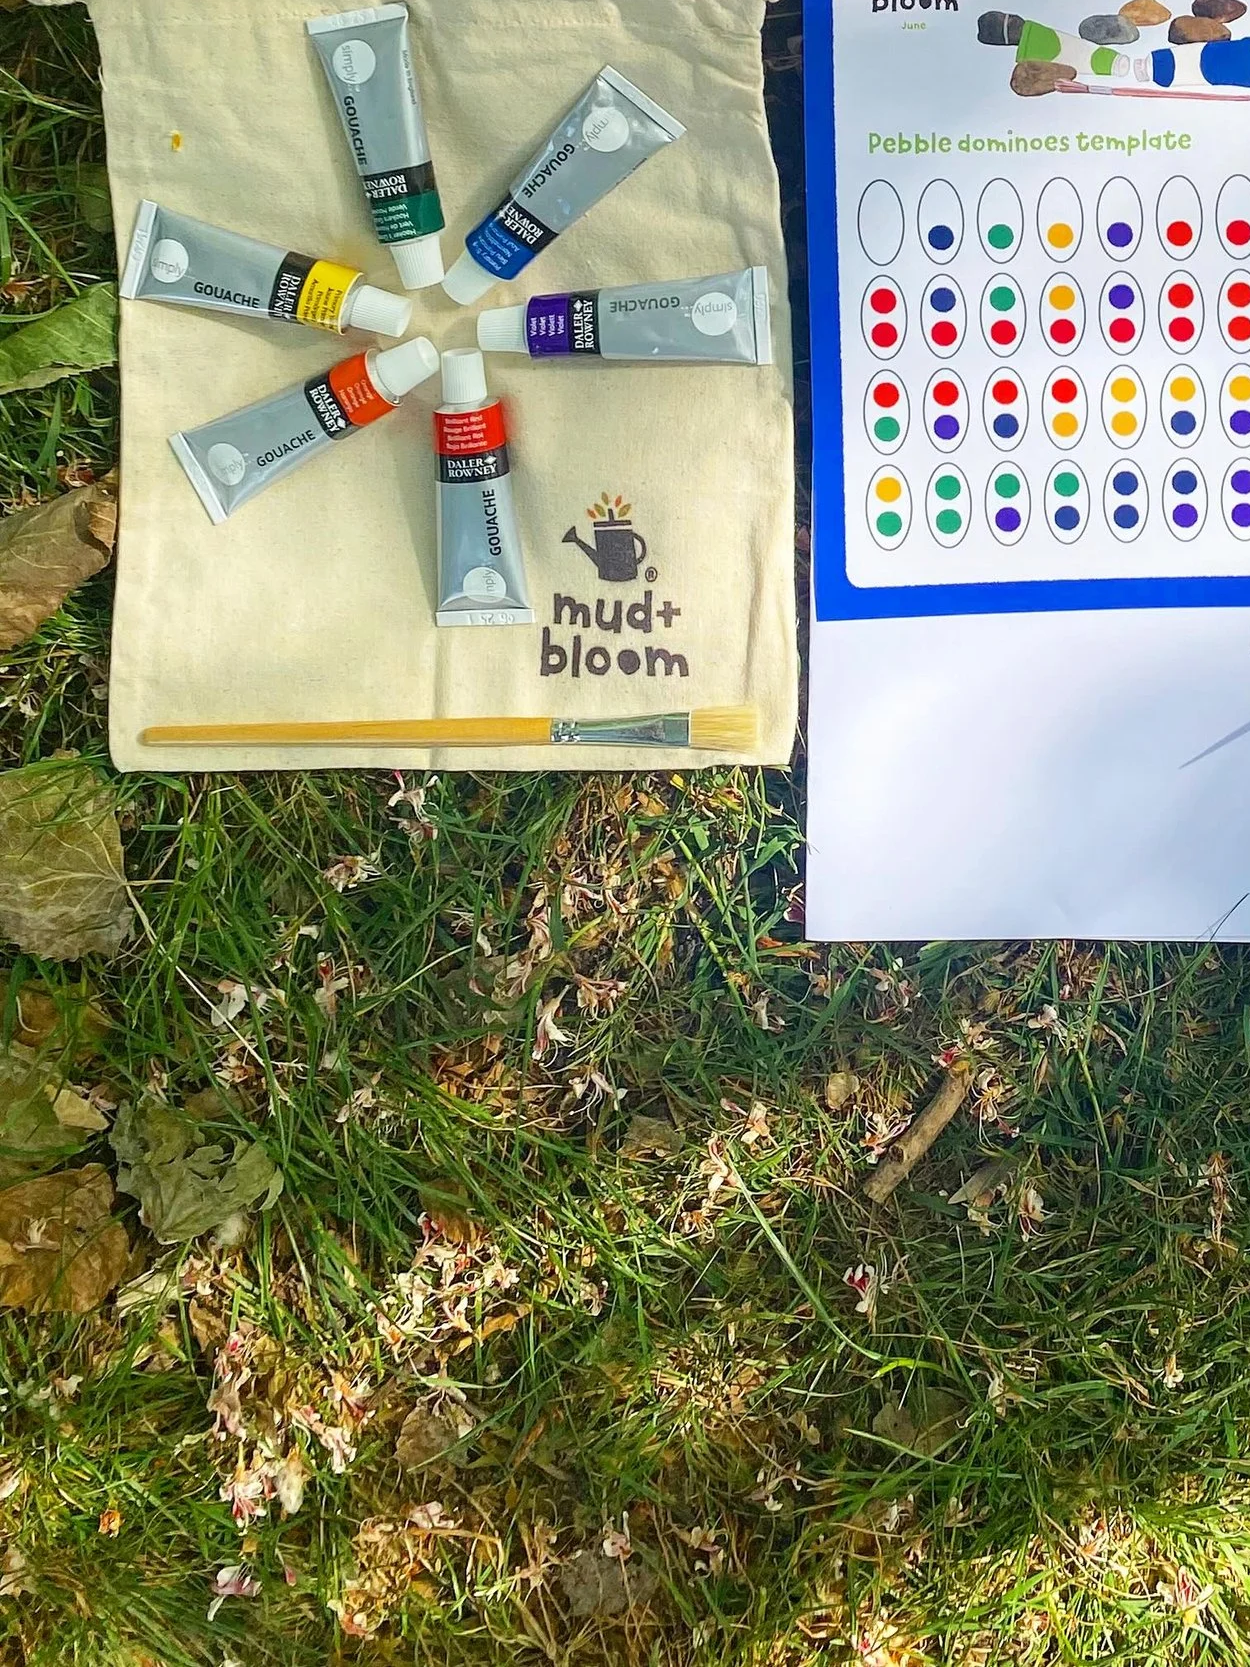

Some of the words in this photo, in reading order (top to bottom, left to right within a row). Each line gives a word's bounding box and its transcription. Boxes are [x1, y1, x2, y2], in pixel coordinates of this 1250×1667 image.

[900, 21, 926, 30] June
[340, 44, 356, 86] simply
[343, 95, 368, 166] GOUACHE
[868, 131, 952, 154] Pebble
[957, 129, 1070, 152] dominoes
[1074, 129, 1192, 156] template
[521, 143, 575, 199] GOUACHE
[151, 256, 184, 278] simply
[193, 281, 261, 309] GOUACHE
[608, 296, 680, 314] GOUACHE
[693, 301, 733, 317] simply
[574, 311, 584, 350] DALER
[583, 299, 595, 350] ROWNEY
[309, 387, 340, 434] ROWNEY
[316, 383, 342, 419] DALER
[255, 428, 317, 468] GOUACHE
[447, 457, 485, 469] DALER
[448, 463, 497, 478] ROWNEY
[482, 488, 502, 556] GOUACHE
[552, 589, 681, 634] mud+
[539, 628, 689, 677] bloom
